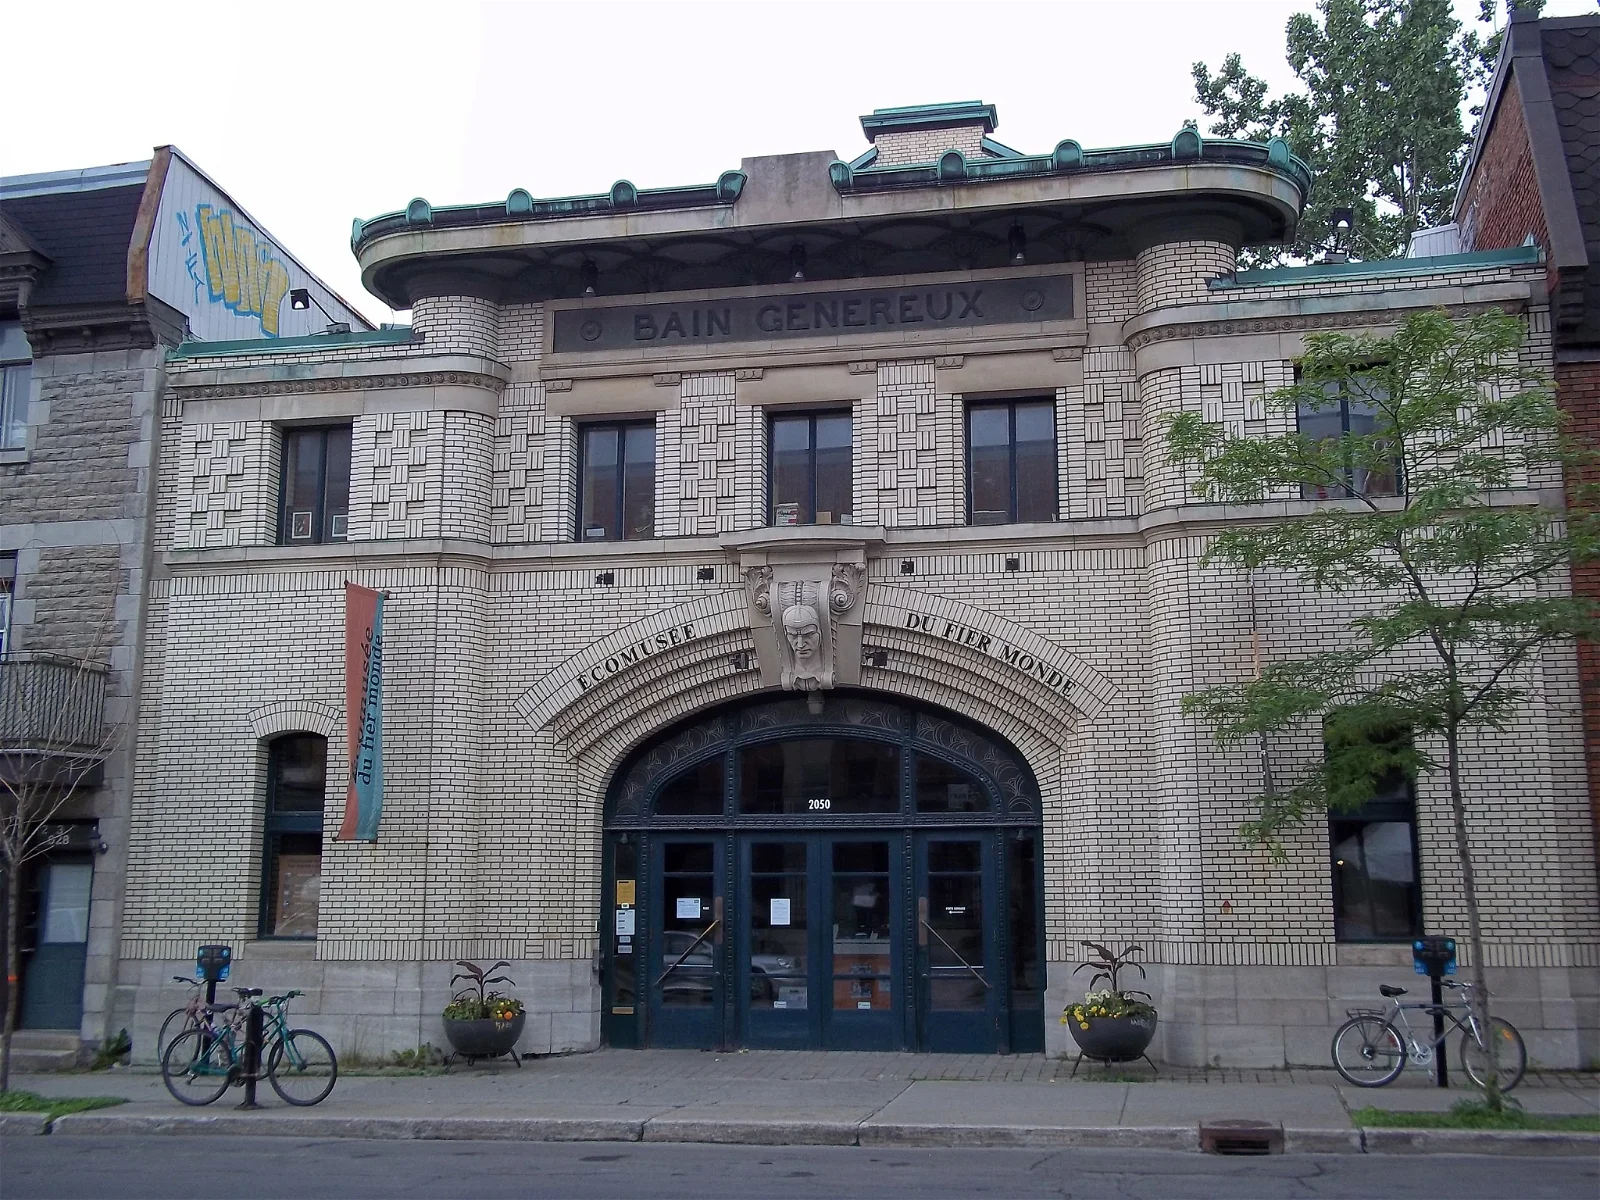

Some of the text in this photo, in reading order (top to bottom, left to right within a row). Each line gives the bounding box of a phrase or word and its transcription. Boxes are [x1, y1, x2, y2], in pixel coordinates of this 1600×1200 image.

[634, 289, 985, 342] BAIN GENEREUX
[905, 613, 937, 632] DU
[942, 623, 992, 652] FIER
[998, 645, 1078, 698] MONDE
[358, 634, 383, 785] du fier monde
[808, 799, 831, 810] 2050
